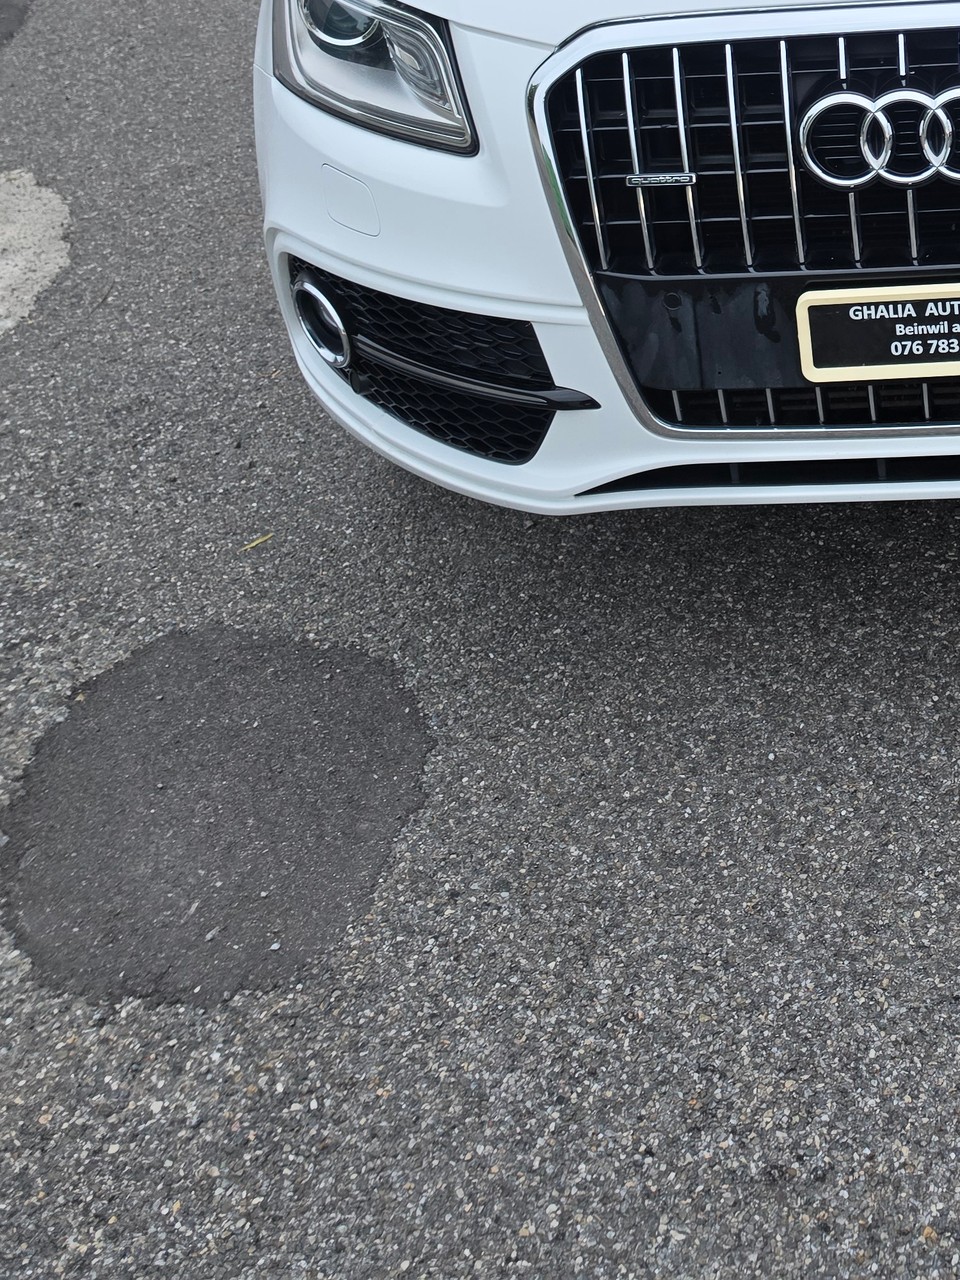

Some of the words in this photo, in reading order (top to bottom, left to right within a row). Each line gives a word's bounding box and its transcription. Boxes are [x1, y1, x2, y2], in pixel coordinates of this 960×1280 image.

[631, 176, 690, 185] quattro
[848, 302, 917, 320] GHALIA
[895, 321, 949, 336] Beinwil
[890, 340, 924, 356] 076
[926, 338, 960, 354] 783
